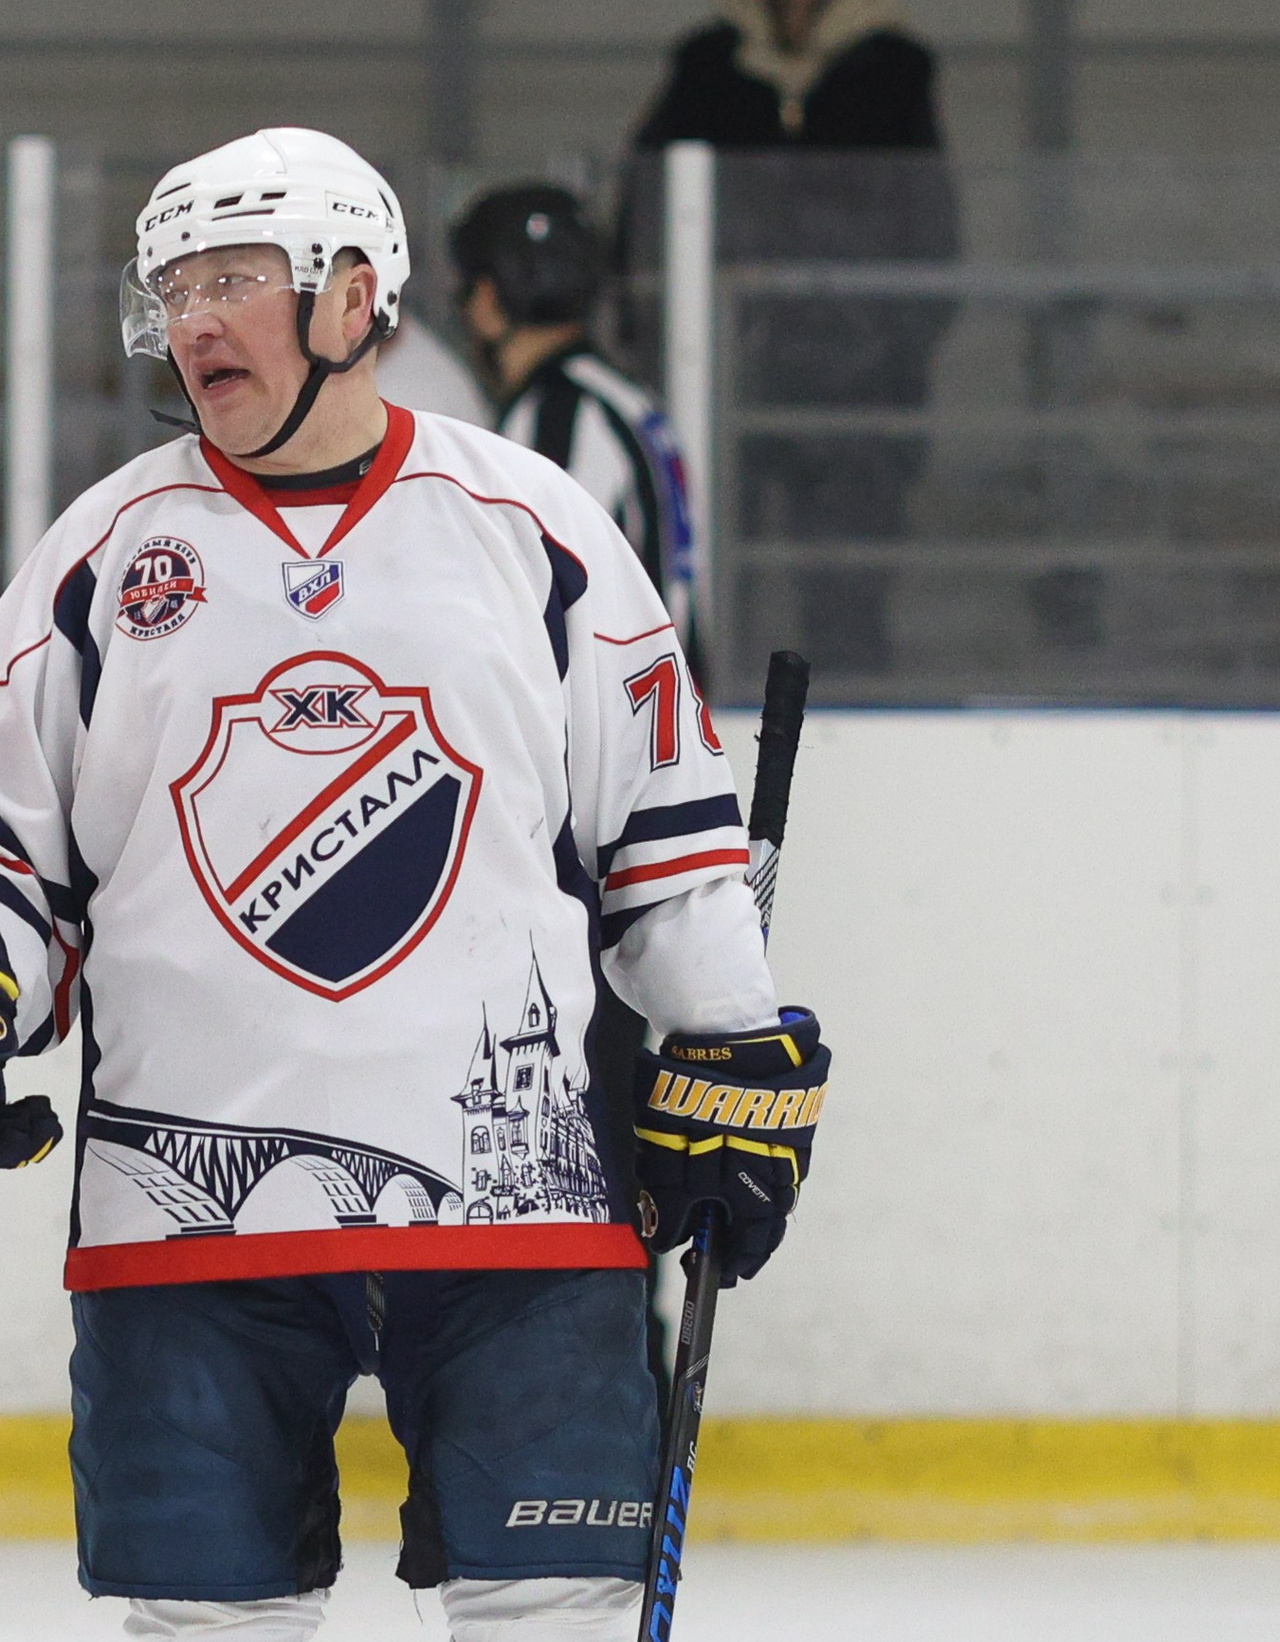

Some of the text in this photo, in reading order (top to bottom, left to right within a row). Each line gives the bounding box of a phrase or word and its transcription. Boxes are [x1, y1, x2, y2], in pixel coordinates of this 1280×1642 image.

[145, 199, 195, 232] CCM
[135, 554, 173, 587] 70
[279, 687, 365, 729] ХК
[237, 748, 441, 935] КРИСТАЛЛ
